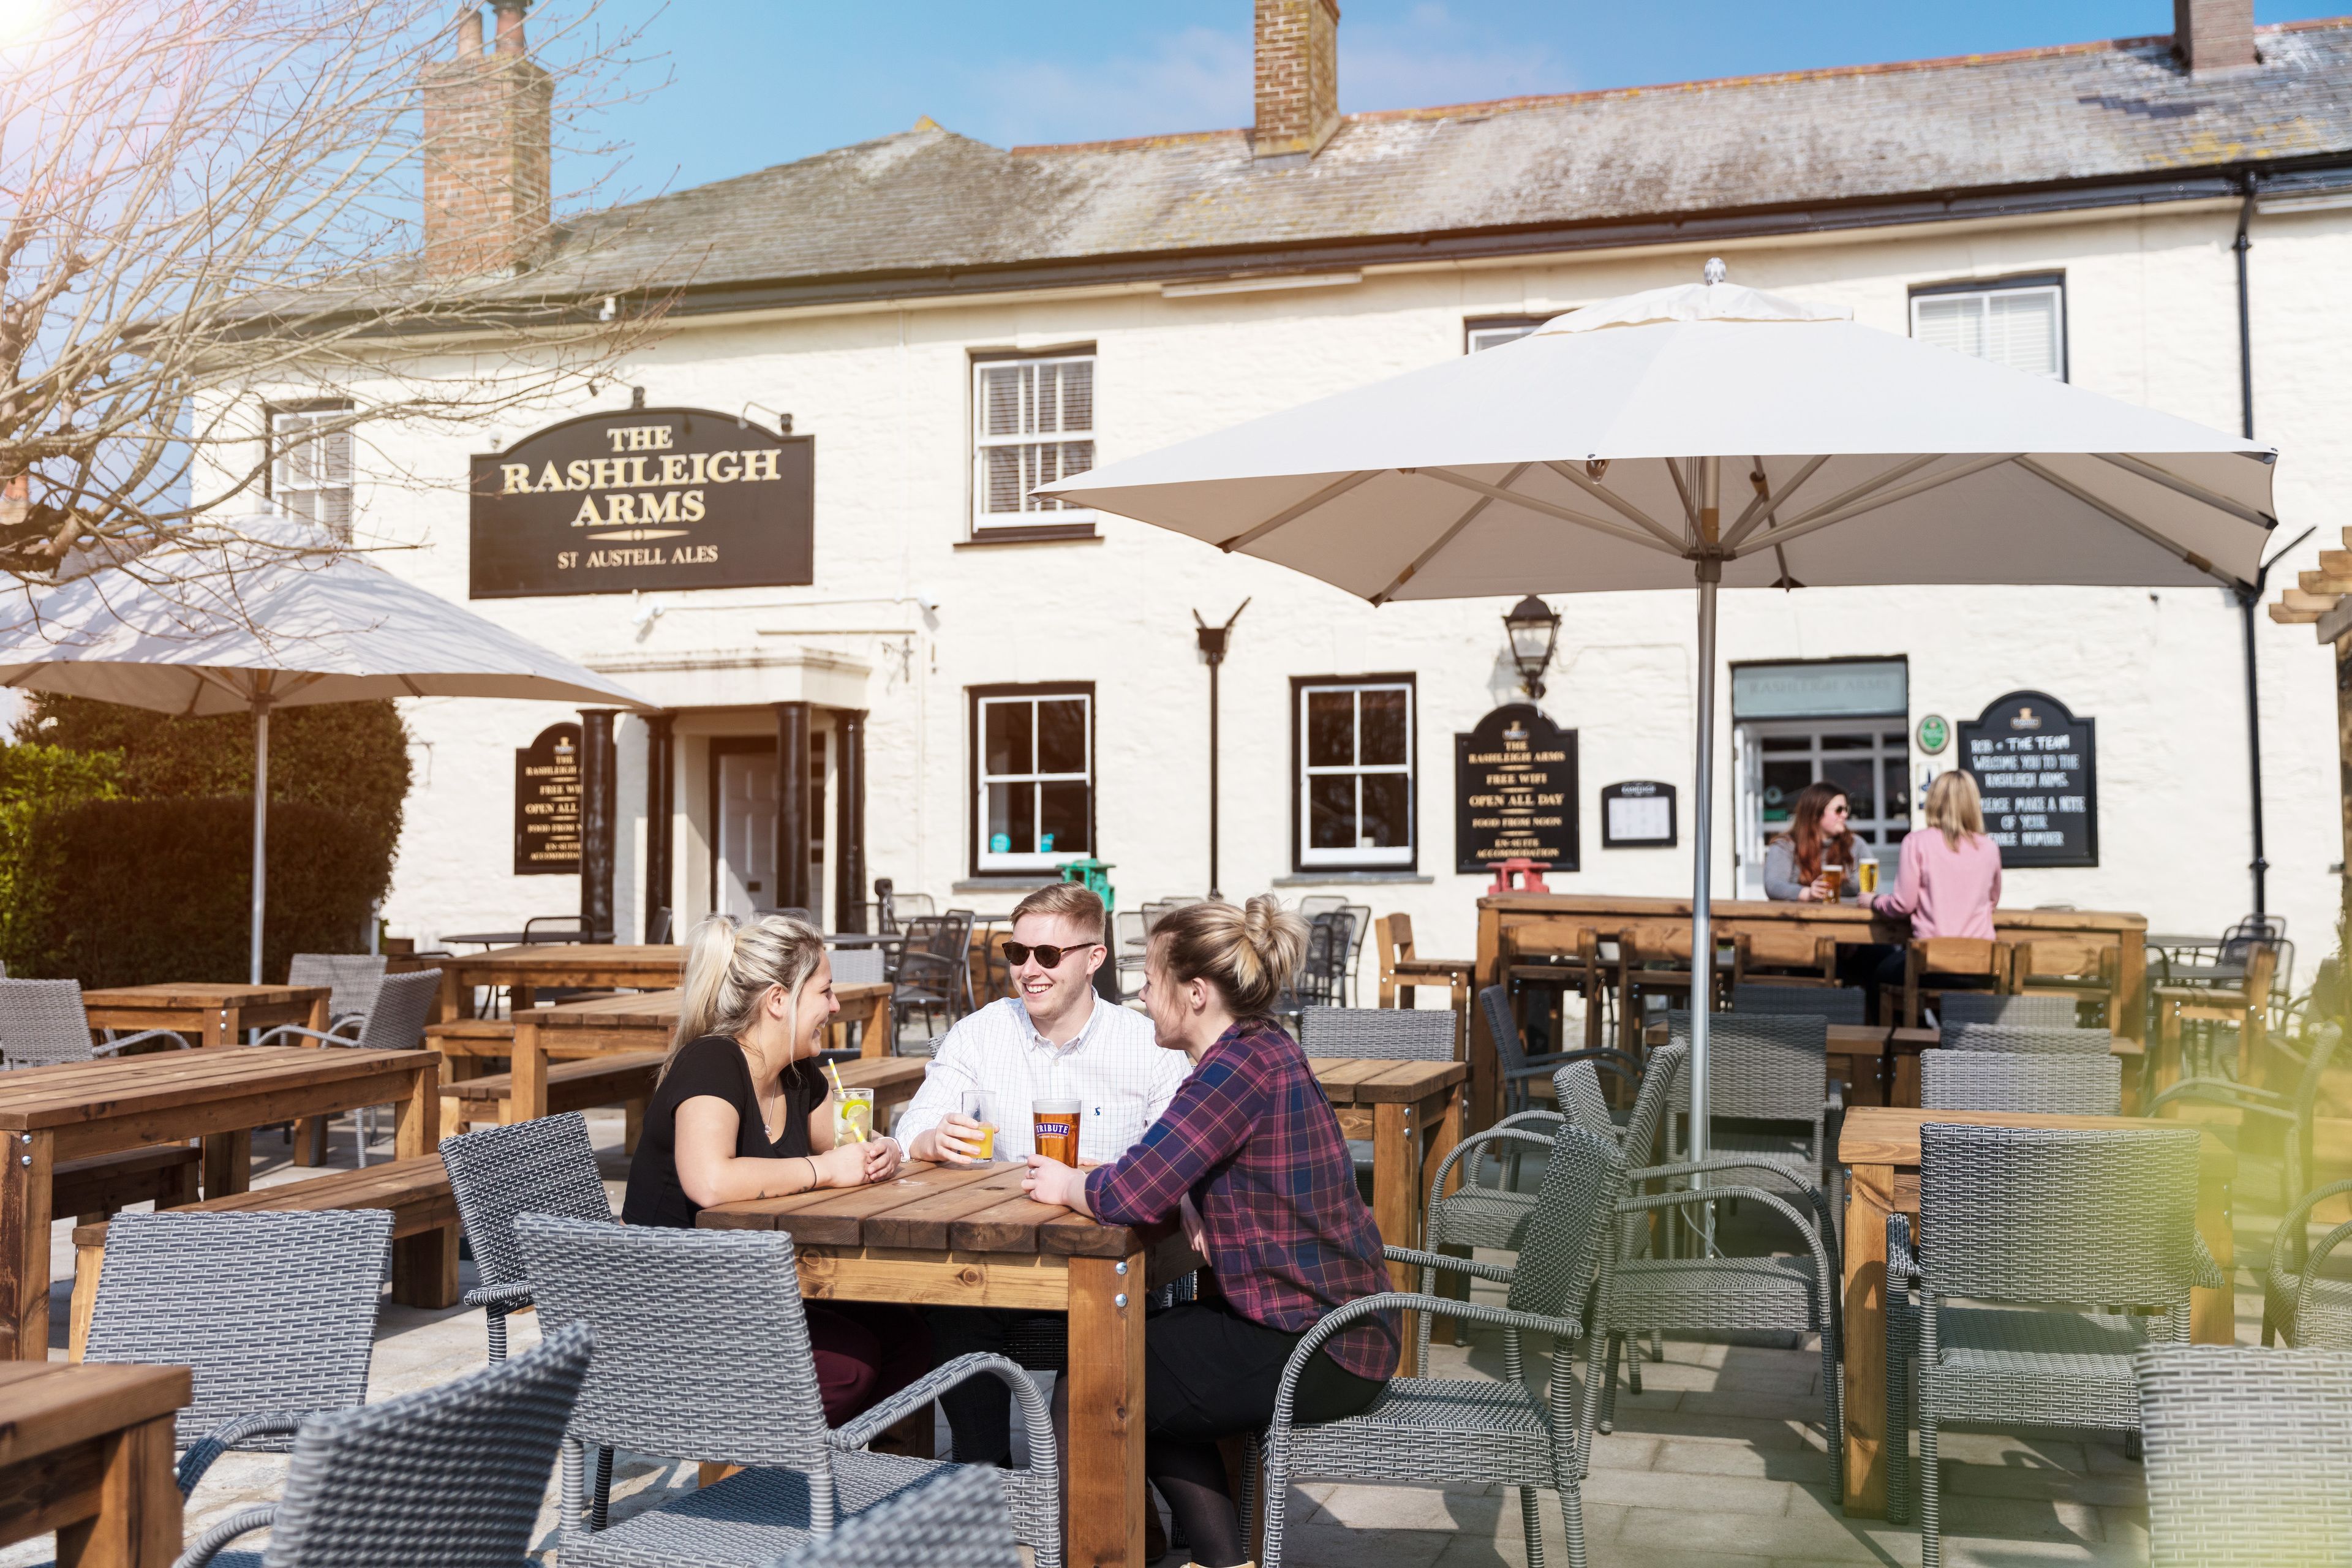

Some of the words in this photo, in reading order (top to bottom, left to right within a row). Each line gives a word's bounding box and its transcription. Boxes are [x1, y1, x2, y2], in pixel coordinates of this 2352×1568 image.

[607, 425, 673, 452] THE
[500, 449, 782, 494] RASHLEIGH
[571, 490, 706, 527] ARMS
[586, 548, 666, 568] AUSTELL
[671, 545, 718, 564] ALES
[1504, 741, 1529, 752] THE
[2005, 736, 2034, 752] THE
[2034, 734, 2070, 750] TEAM
[1468, 752, 1532, 764] RASHLEIGH
[1533, 751, 1566, 762] ARMS
[1486, 774, 1517, 785] FREE
[1469, 795, 1506, 808] OPEN
[1507, 794, 1536, 807] ALL
[1537, 793, 1565, 806] DAY
[2048, 796, 2057, 812] A
[525, 803, 554, 815] OPEN
[556, 802, 579, 814] ALL
[1472, 818, 1501, 828] FOOD
[1502, 817, 1531, 827] FROM
[1532, 816, 1562, 826] NOON
[2000, 815, 2017, 830] OF
[1036, 1124, 1069, 1133] TRIBUTE
